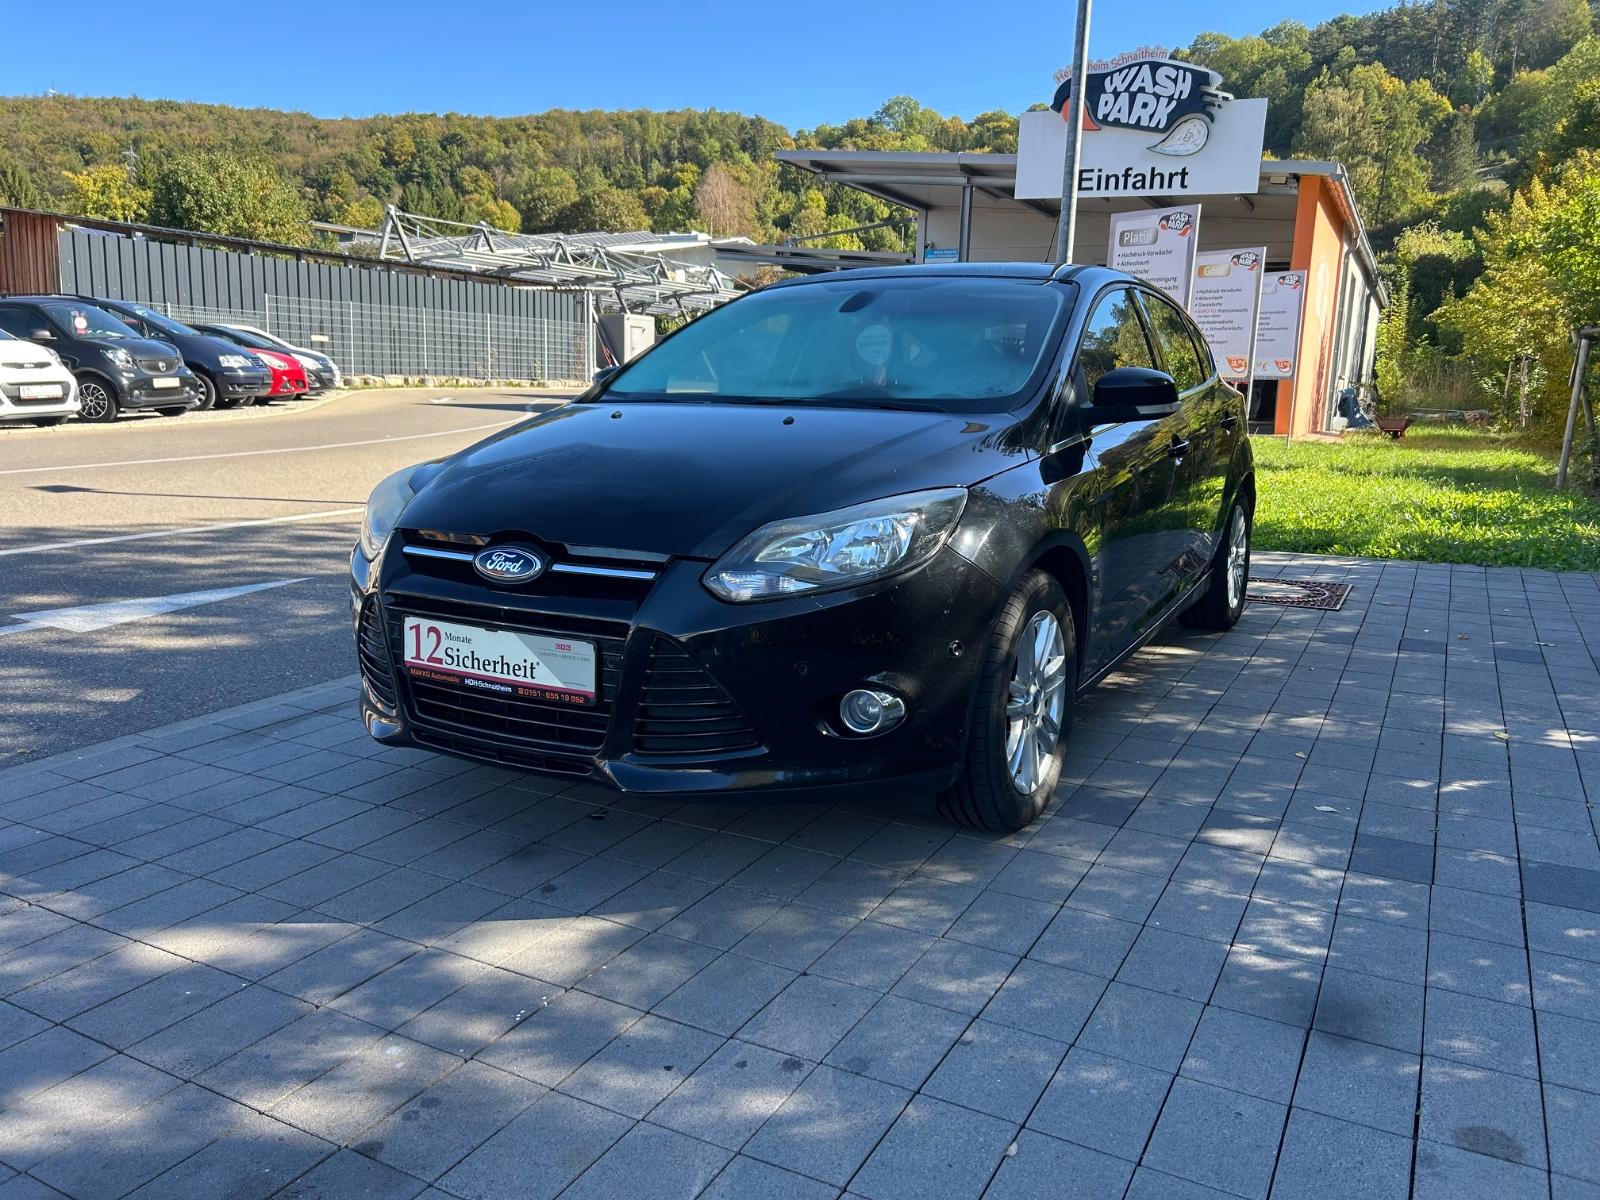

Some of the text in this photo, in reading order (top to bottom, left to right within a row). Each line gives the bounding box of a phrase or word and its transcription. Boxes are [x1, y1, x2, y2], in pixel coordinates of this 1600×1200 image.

[1055, 47, 1168, 83] Heiheim Schnaitheim
[1104, 64, 1192, 99] WASH
[1097, 93, 1177, 129] PARK
[1078, 166, 1189, 191] Einfahrt
[486, 551, 524, 573] Ford
[409, 622, 444, 666] 12
[444, 632, 473, 645] Monate
